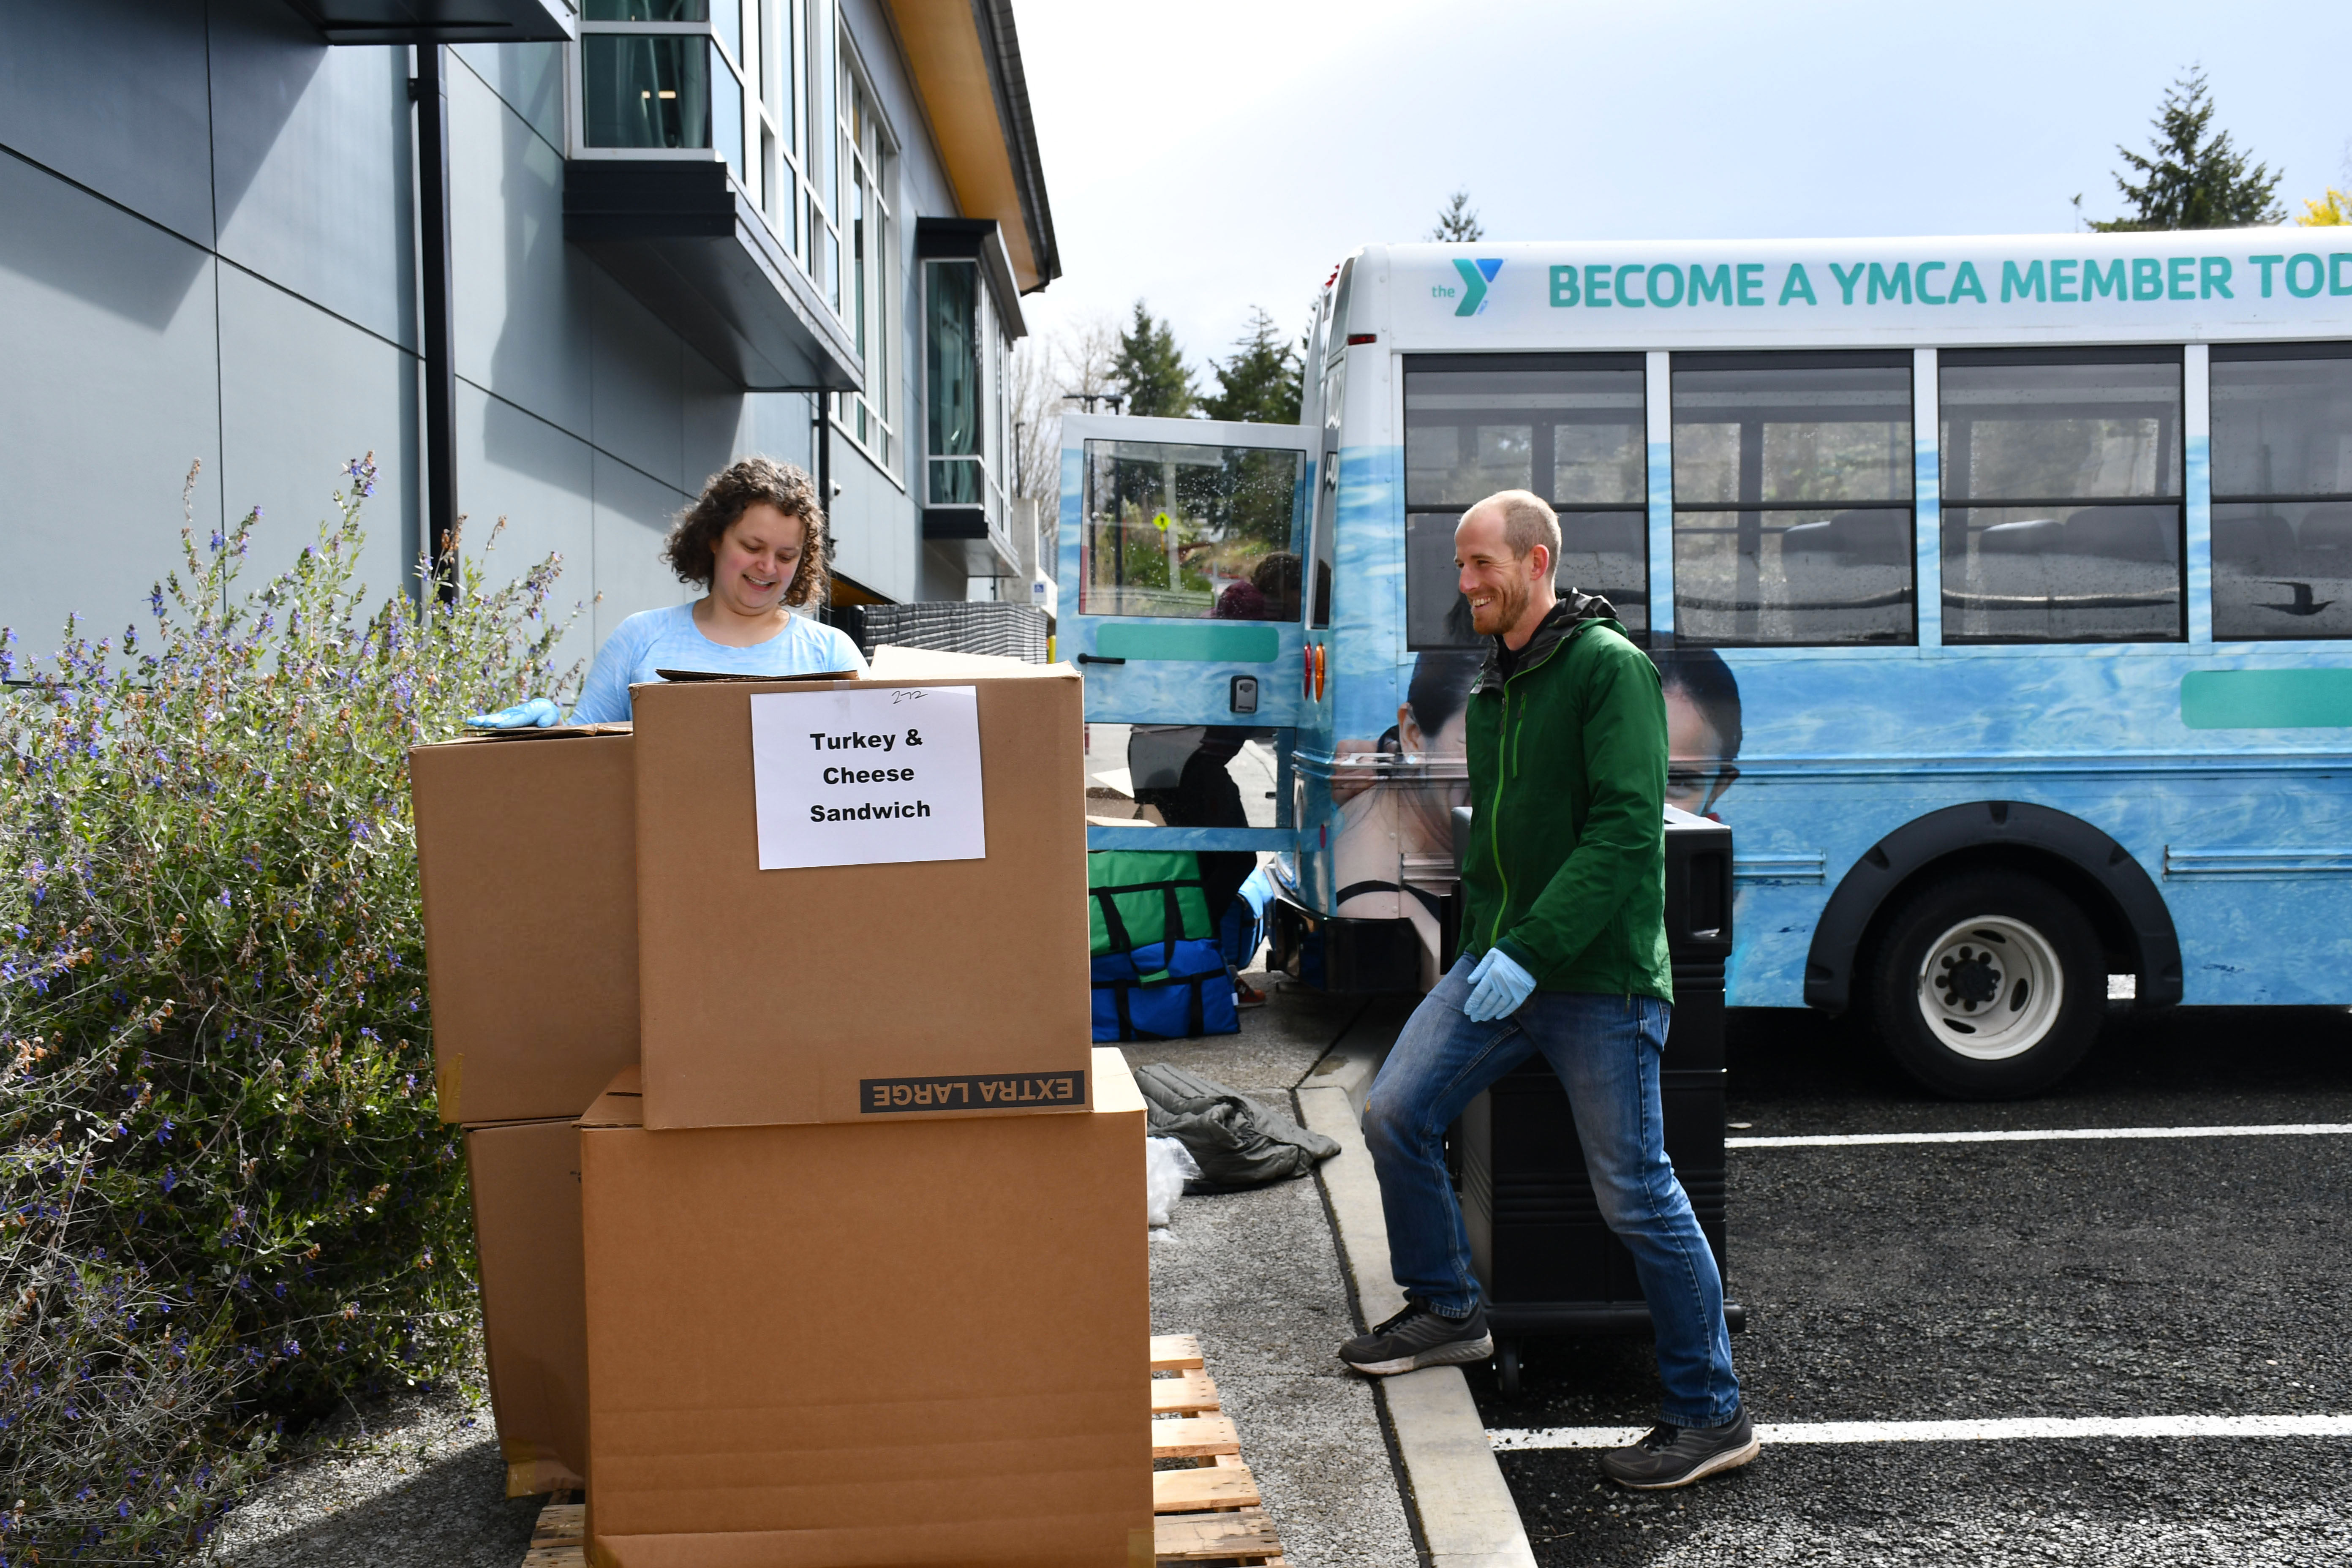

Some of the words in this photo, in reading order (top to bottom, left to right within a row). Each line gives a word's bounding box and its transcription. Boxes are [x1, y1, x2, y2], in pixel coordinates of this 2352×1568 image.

[1432, 285, 1455, 298] the
[1549, 263, 1765, 308] BECOME
[1778, 263, 1817, 306] A
[1829, 261, 1987, 305] YMCA
[2001, 256, 2234, 303] MEMBER
[2249, 253, 2352, 299] TOD
[891, 690, 928, 704] 272
[810, 732, 896, 752] Turkey
[905, 729, 923, 746] &
[823, 767, 915, 784] Cheese
[810, 800, 931, 822] Sandwich
[873, 1083, 969, 1106] LARGE
[978, 1078, 1073, 1102] EXTRA
